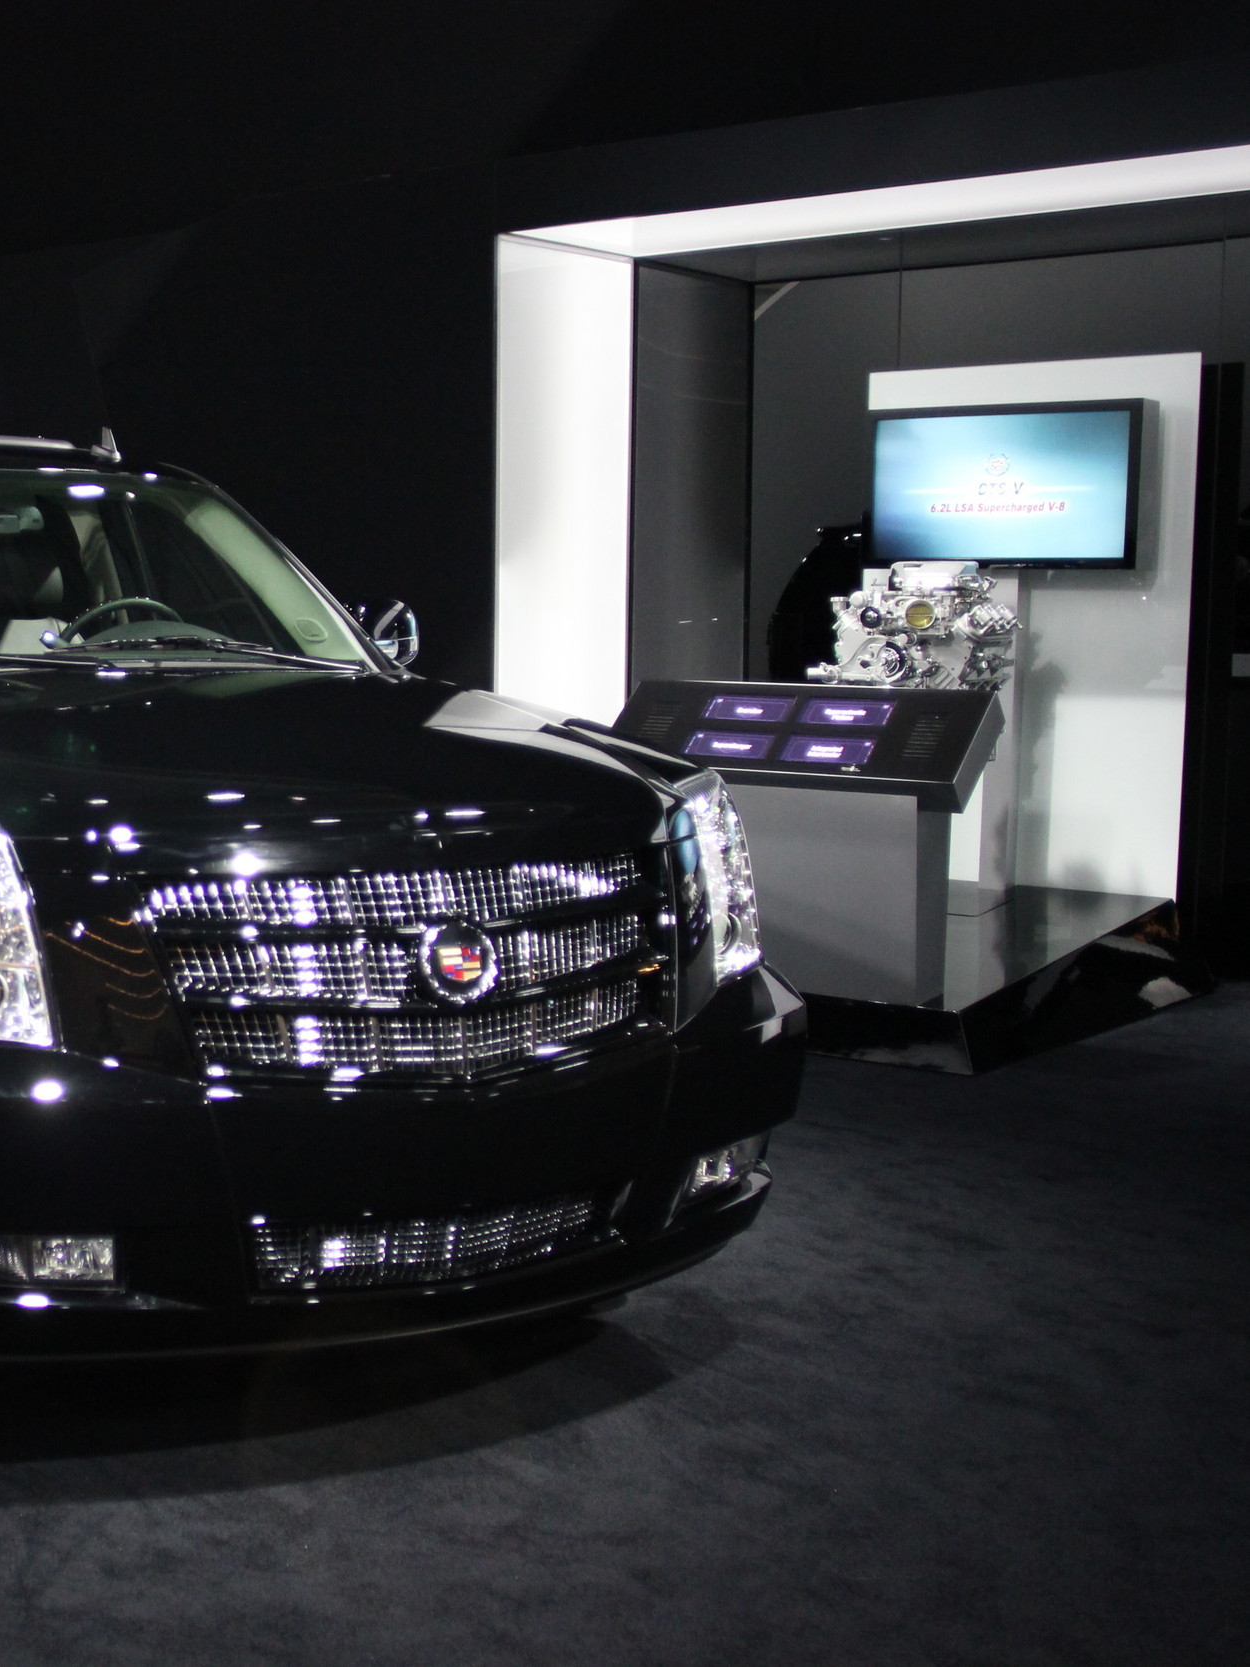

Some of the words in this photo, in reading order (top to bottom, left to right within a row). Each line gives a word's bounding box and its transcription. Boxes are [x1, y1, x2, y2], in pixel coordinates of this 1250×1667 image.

[930, 503, 951, 513] 6.2L
[954, 503, 974, 513] LSA
[977, 501, 1045, 514] Supercharged
[1048, 501, 1066, 511] V-8
